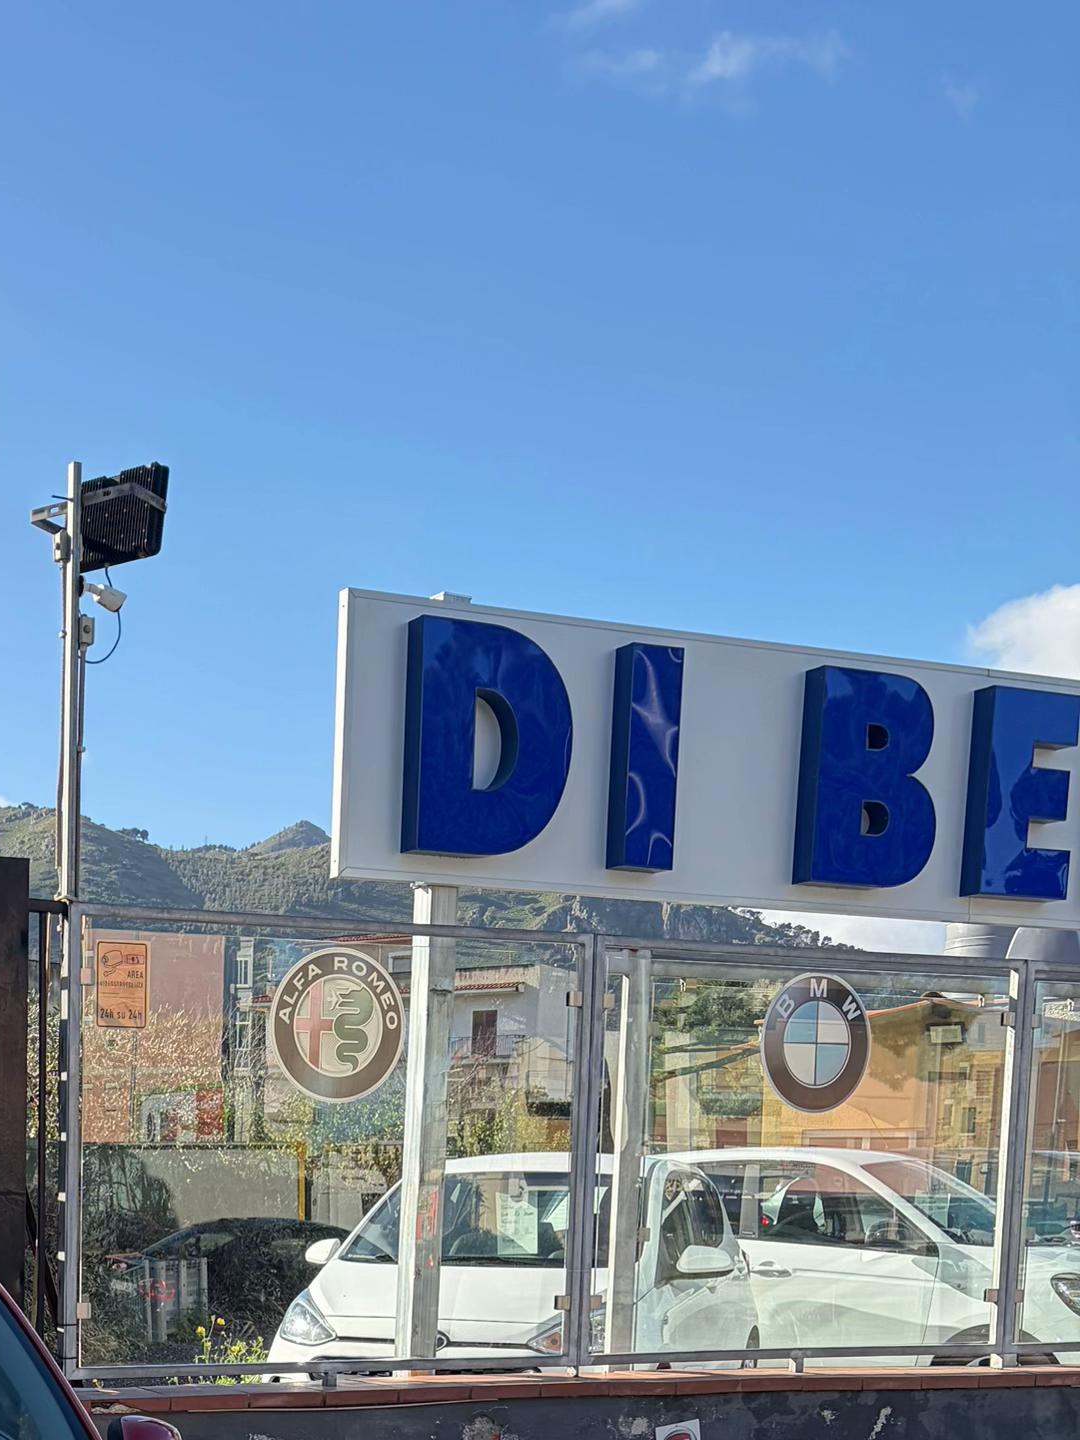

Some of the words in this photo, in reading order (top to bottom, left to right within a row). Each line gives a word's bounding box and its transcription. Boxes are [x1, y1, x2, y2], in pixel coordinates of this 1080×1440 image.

[400, 614, 684, 873] DI
[792, 665, 1080, 902] BE
[127, 970, 144, 979] AREA
[279, 963, 322, 1024] ALFA
[333, 956, 399, 1030] ROMEO
[100, 1008, 114, 1019] 24h
[117, 1010, 126, 1019] su
[128, 1009, 142, 1020] 24h
[775, 978, 861, 1021] BMW
